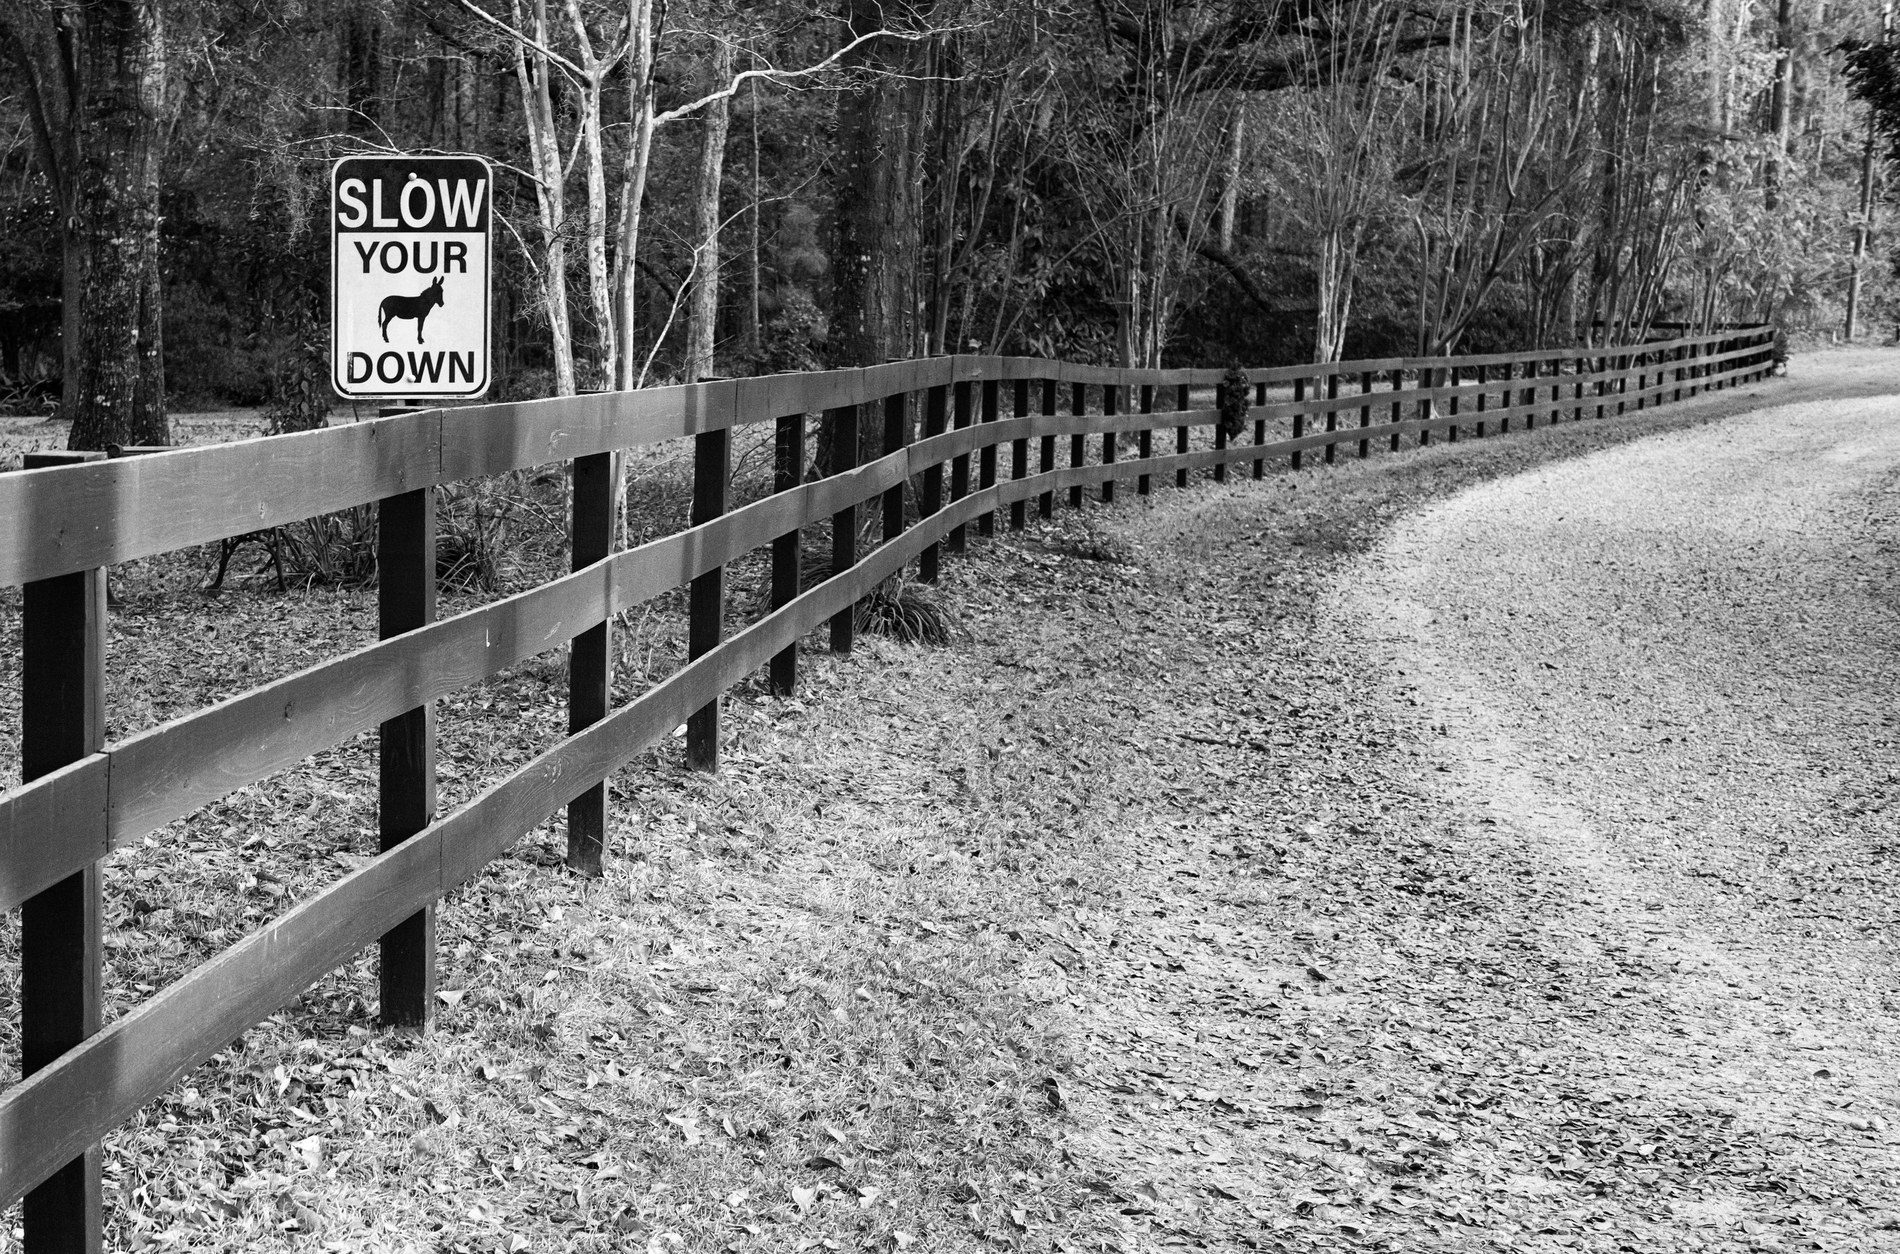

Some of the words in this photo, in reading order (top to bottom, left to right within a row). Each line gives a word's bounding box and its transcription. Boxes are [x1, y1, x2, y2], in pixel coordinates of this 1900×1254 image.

[338, 178, 486, 228] SLOW
[353, 241, 467, 274] YOUR
[347, 351, 475, 384] DOWN
